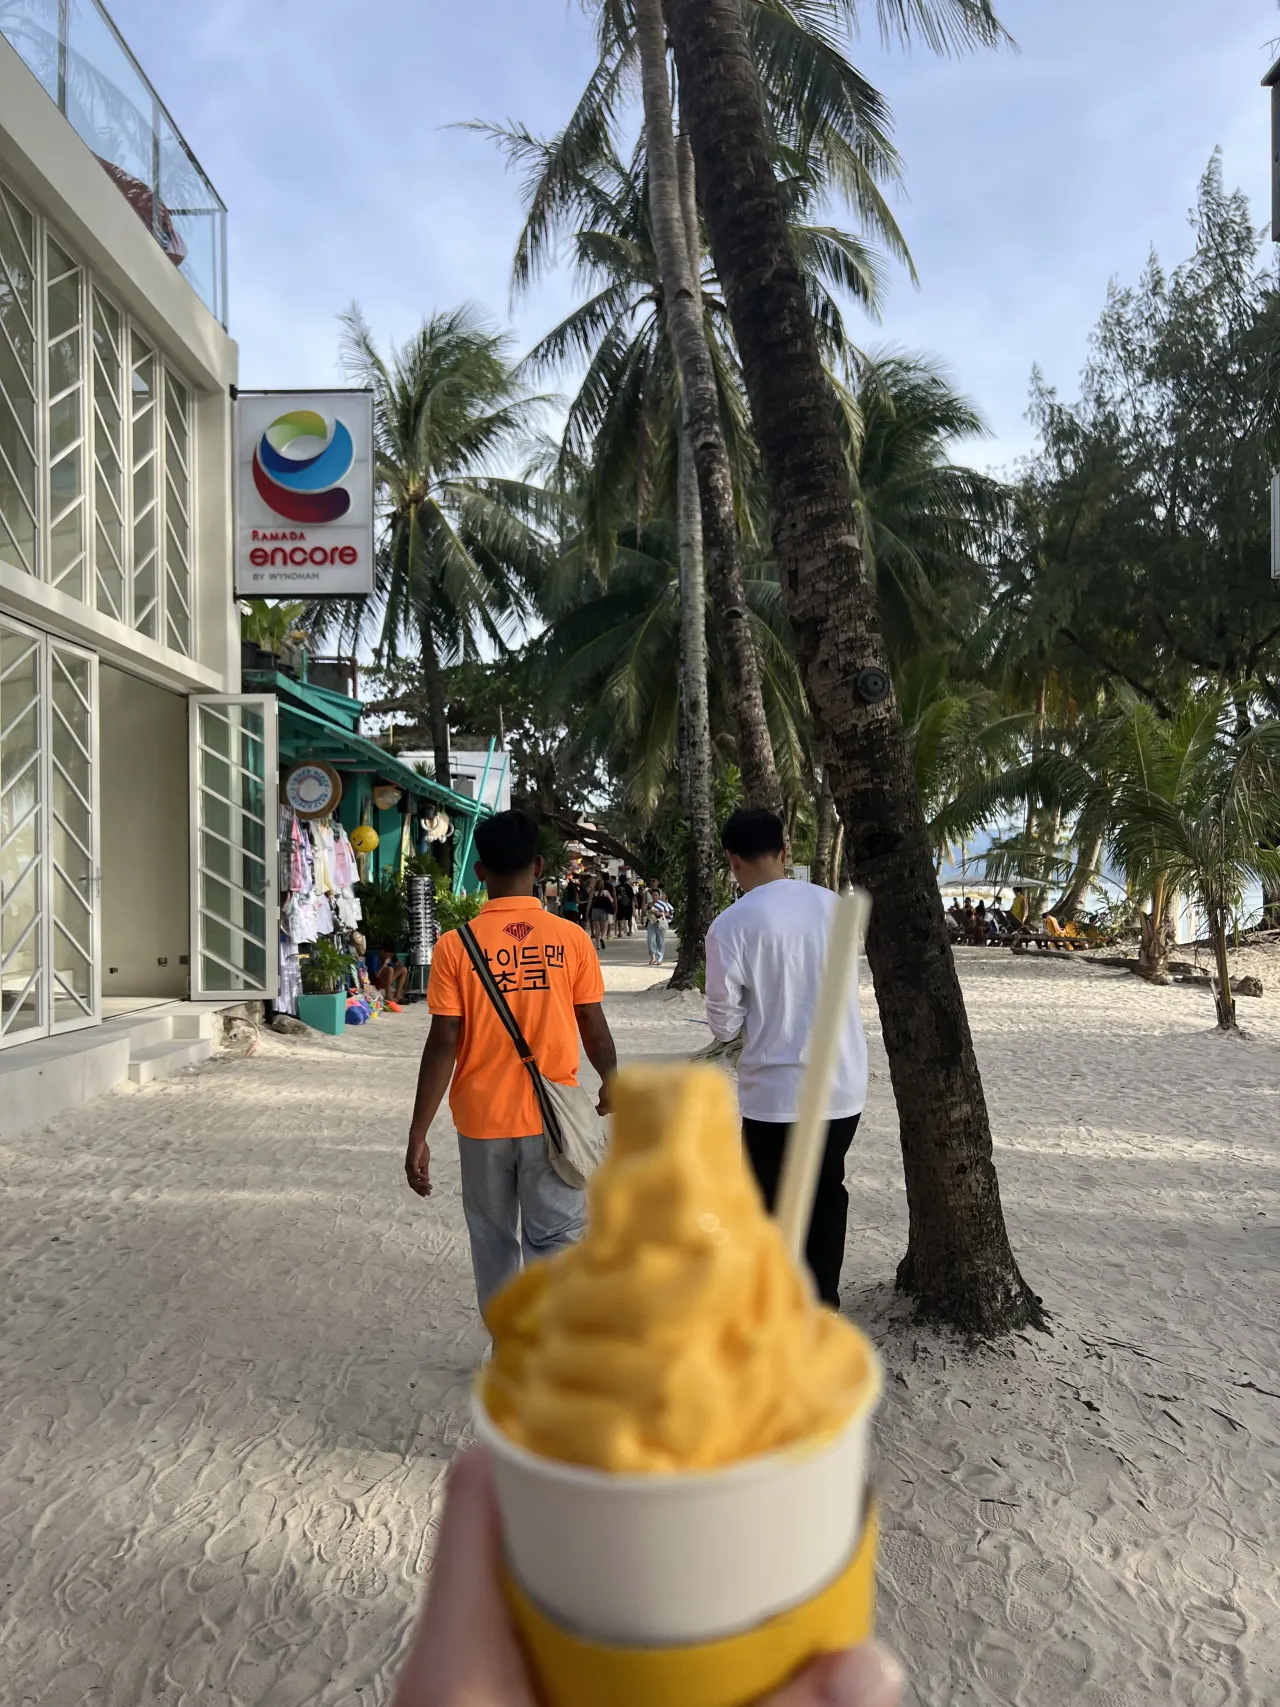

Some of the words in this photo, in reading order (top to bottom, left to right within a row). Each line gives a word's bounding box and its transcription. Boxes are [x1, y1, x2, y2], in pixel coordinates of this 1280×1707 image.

[251, 530, 306, 541] RAMADA
[249, 545, 358, 567] encore
[252, 573, 265, 581] BY
[268, 572, 319, 580] WYNDHAM
[492, 969, 551, 994] 초코
